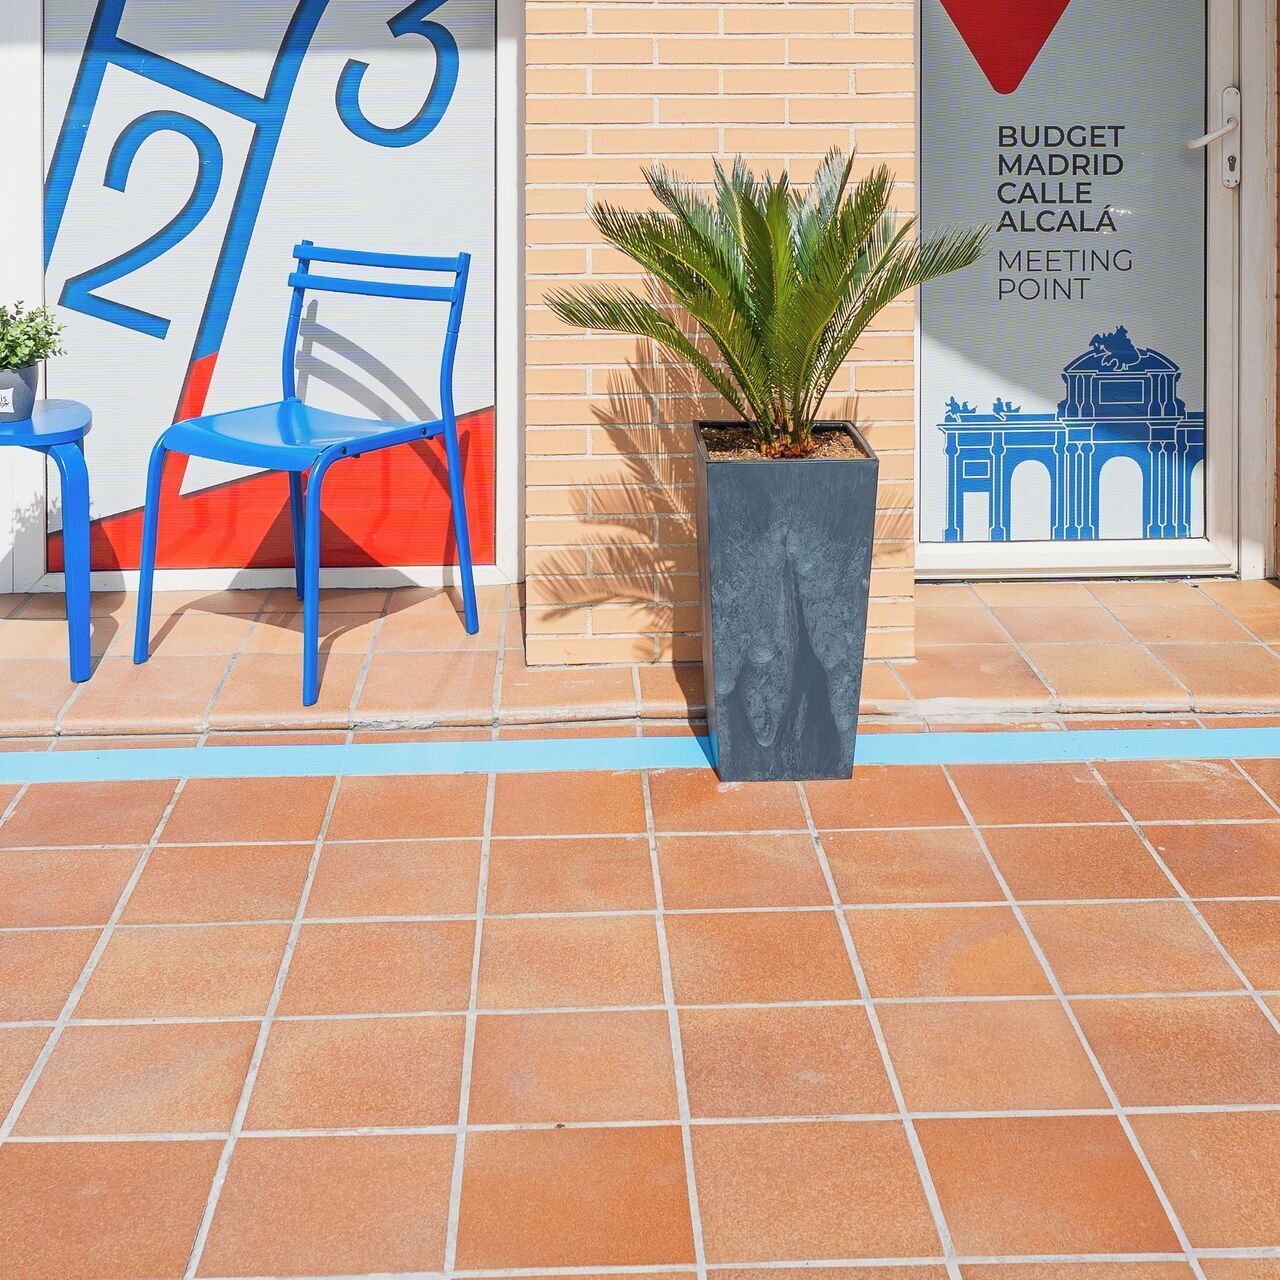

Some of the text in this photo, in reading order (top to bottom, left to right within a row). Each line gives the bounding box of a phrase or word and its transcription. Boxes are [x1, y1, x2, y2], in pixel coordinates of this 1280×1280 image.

[997, 124, 1126, 149] BUDGET
[997, 153, 1124, 177] MADRID
[996, 182, 1093, 205] CALLE
[57, 108, 224, 341] 2
[995, 205, 1117, 233] ALCALÁ
[998, 249, 1134, 273] MEETING
[998, 277, 1091, 301] POINT
